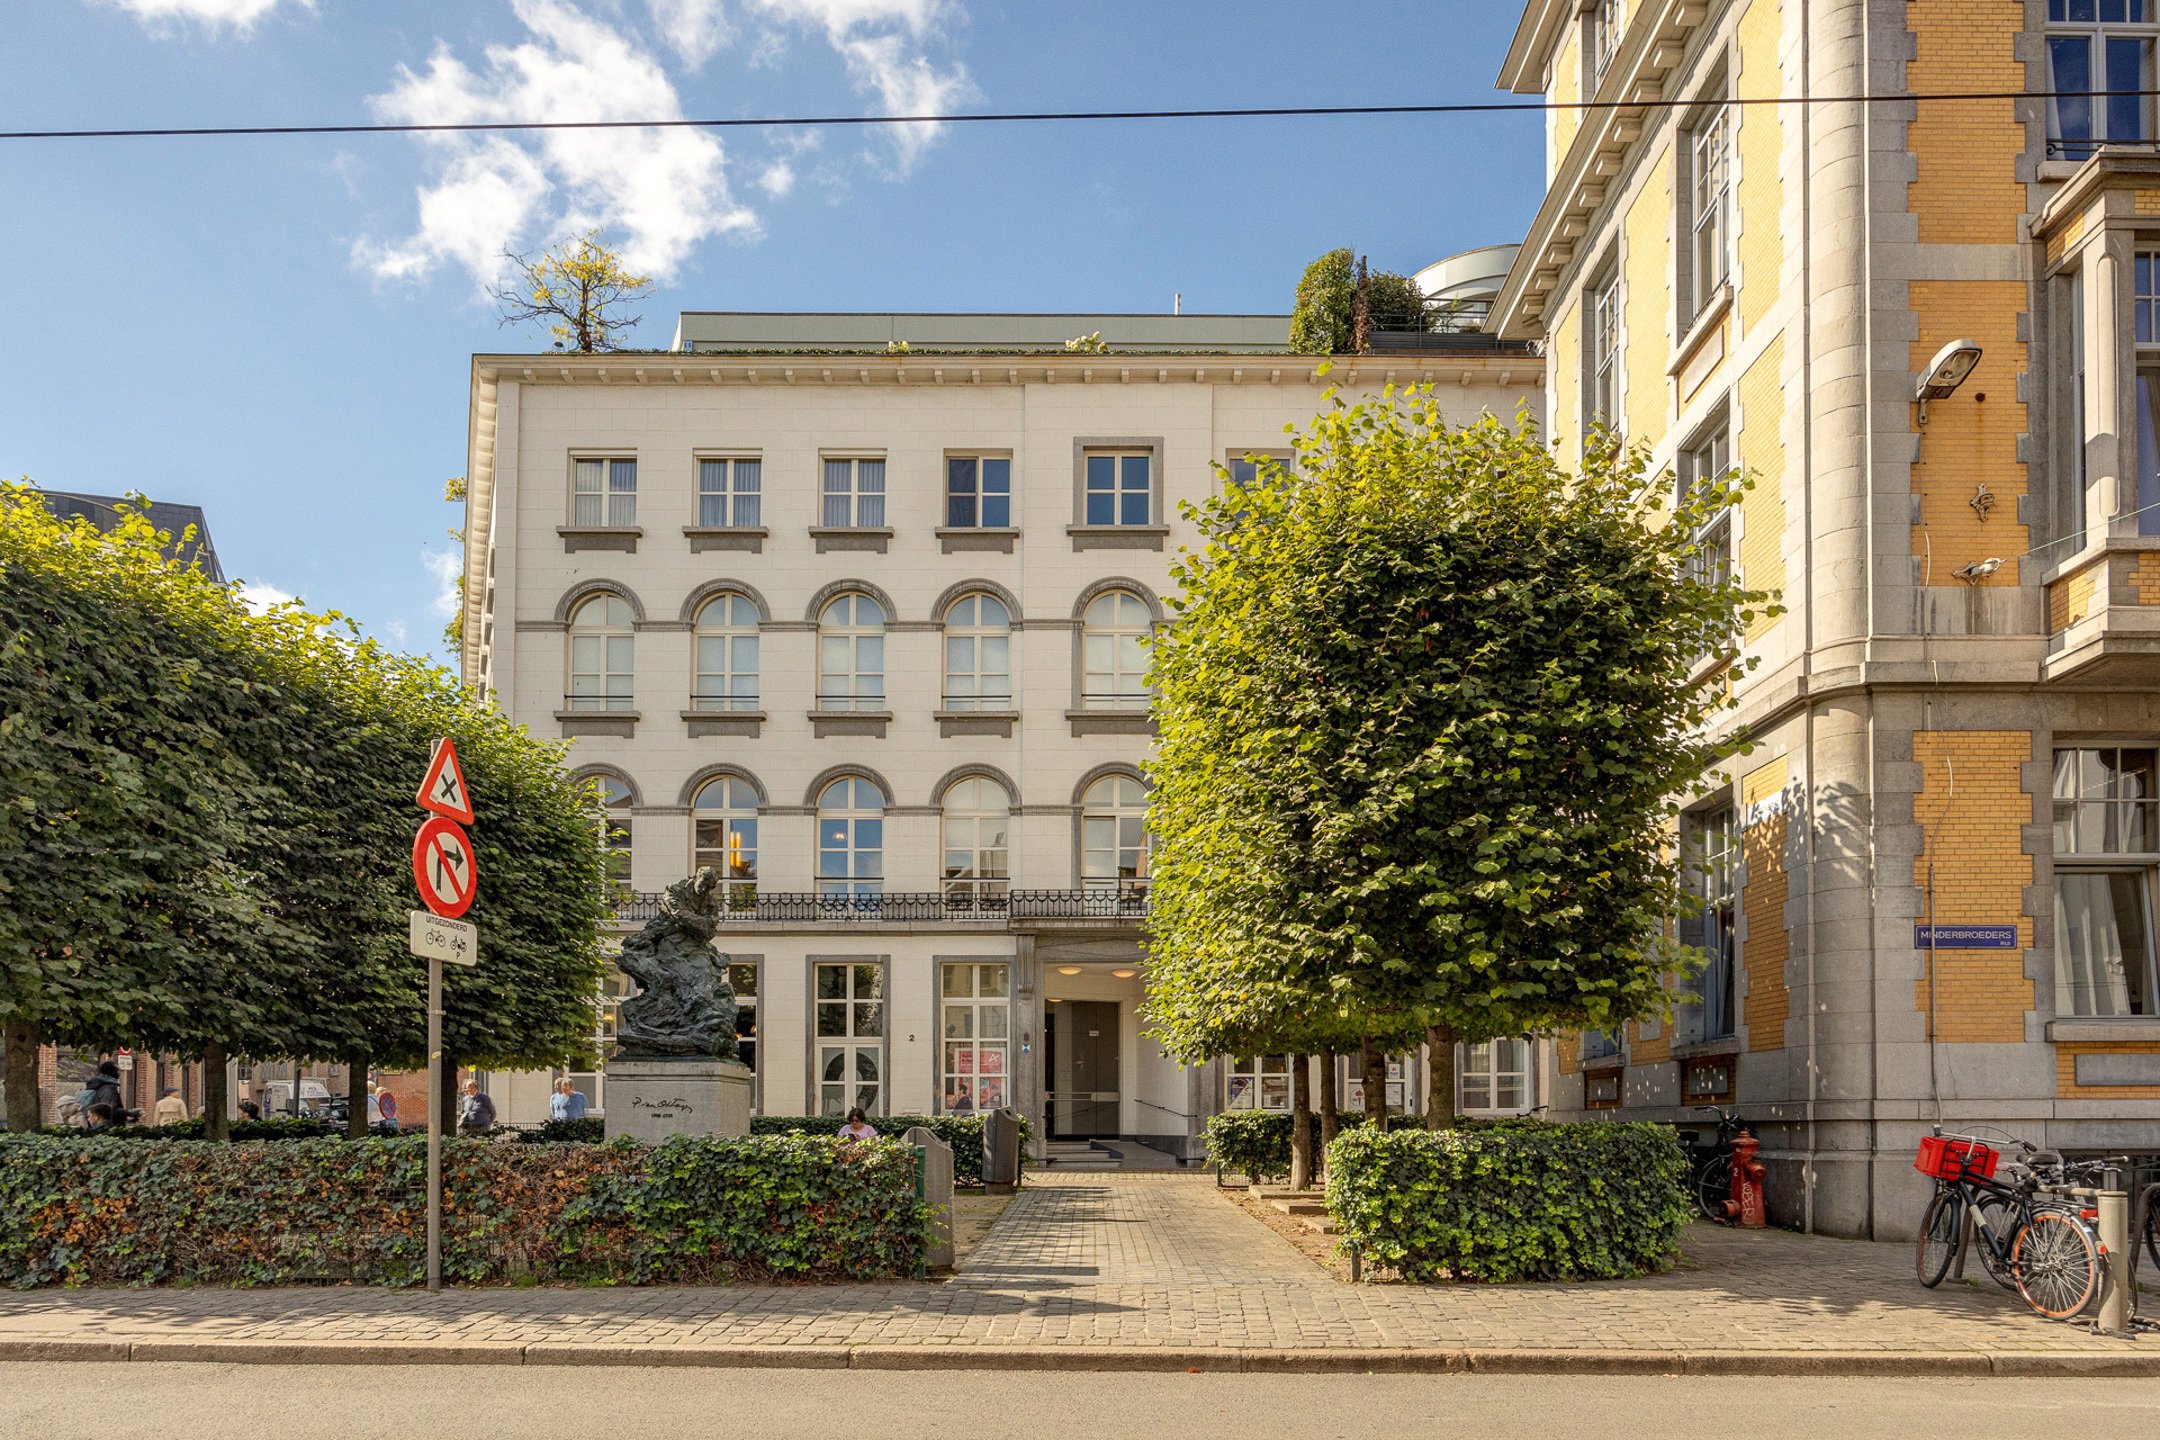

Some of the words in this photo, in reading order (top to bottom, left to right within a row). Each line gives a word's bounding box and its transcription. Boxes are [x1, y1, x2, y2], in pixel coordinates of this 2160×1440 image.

[425, 915, 468, 932] UITGEZONDERD
[1920, 930, 2013, 940] MINDERBROEDERS
[456, 951, 461, 960] P
[908, 1034, 915, 1042] 2
[1733, 1167, 1739, 1177] 2
